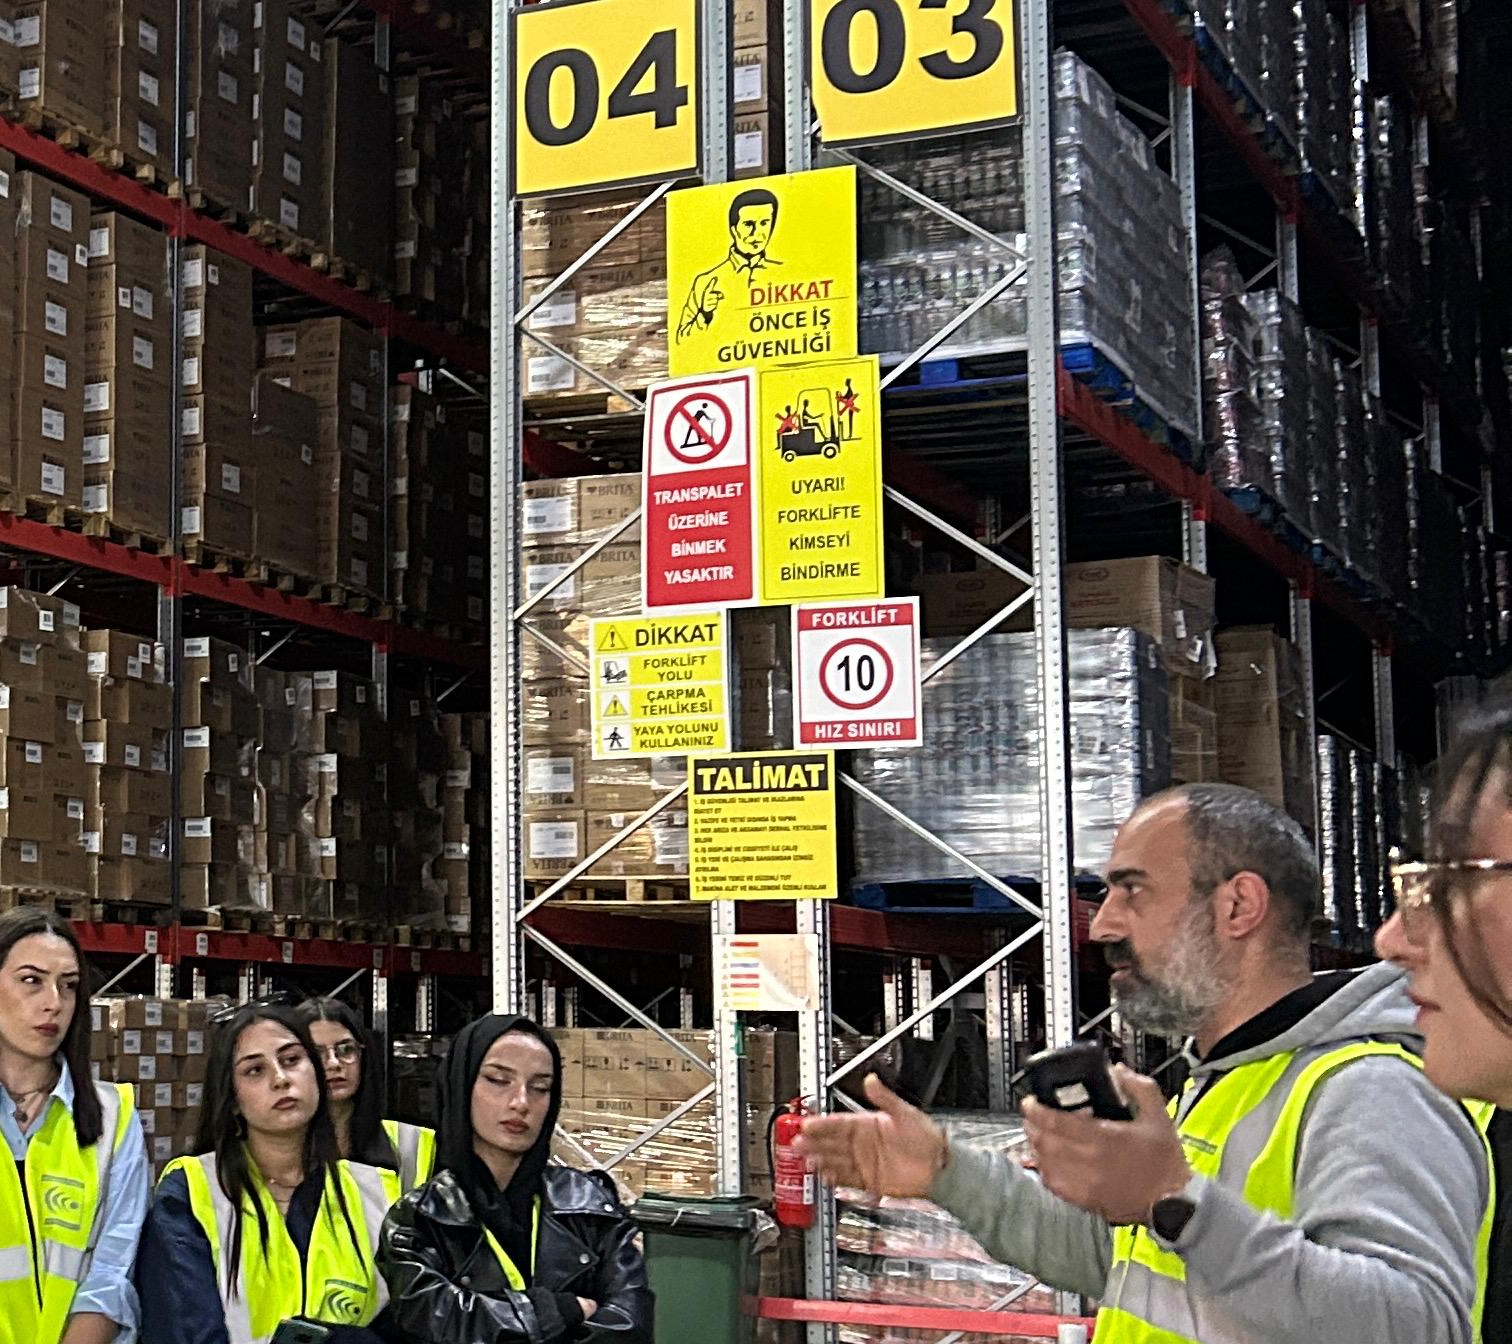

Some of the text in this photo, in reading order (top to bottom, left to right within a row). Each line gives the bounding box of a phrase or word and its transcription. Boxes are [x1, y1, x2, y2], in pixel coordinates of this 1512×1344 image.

[524, 29, 689, 146] 04
[750, 280, 833, 306] DİKKAT
[749, 306, 831, 332] ÖNCE İŞ
[718, 331, 830, 362] GÜVENLİĞİ
[598, 484, 634, 496] BRITA
[653, 482, 744, 505] TRANSPALET
[668, 510, 729, 530] ÜZERİNE
[778, 504, 861, 524] FORKLİFTE
[671, 538, 726, 558] BİNMEK
[789, 531, 850, 551] KİMSEYİ
[538, 552, 574, 564] BRITA
[601, 551, 637, 562] BRITA
[664, 565, 734, 585] YASAKTIR
[781, 561, 861, 581] BİNDİRME
[812, 607, 898, 627] FORKLİFT
[635, 623, 718, 647] DİKKAT
[643, 653, 707, 669] FORKLİFT
[657, 670, 693, 682] YOLU
[837, 654, 875, 692] 10
[647, 688, 706, 703] ÇARPMA
[641, 699, 712, 716] TEHLİKESİ
[633, 722, 719, 736] YAYA YOLUNU
[814, 721, 901, 739] HIZ SINIRI
[640, 735, 714, 749] KULLANINIZ
[697, 760, 826, 791] TALİMAT
